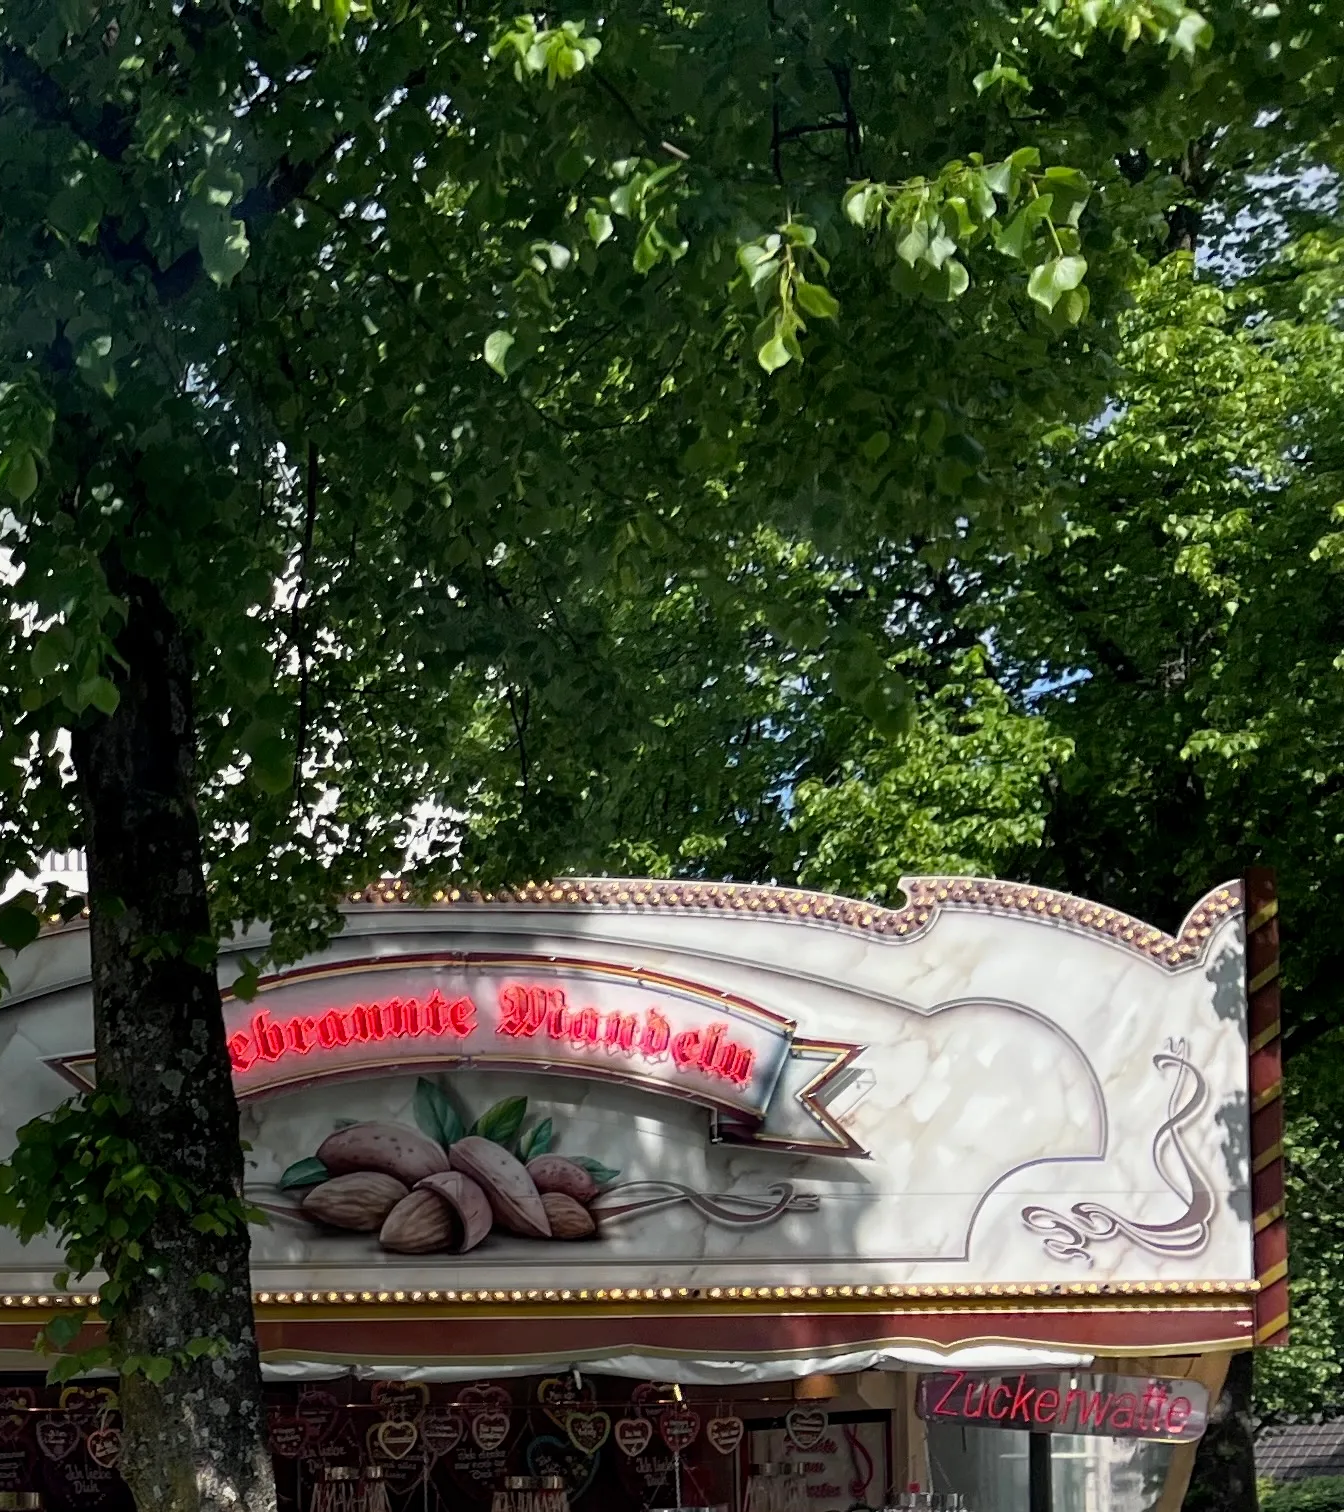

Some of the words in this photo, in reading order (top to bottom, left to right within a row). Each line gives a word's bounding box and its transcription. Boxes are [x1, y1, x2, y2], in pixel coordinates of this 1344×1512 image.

[226, 988, 477, 1073] ebrannte
[496, 984, 756, 1085] Mandeln
[932, 1369, 1192, 1433] Zuckerwatte
